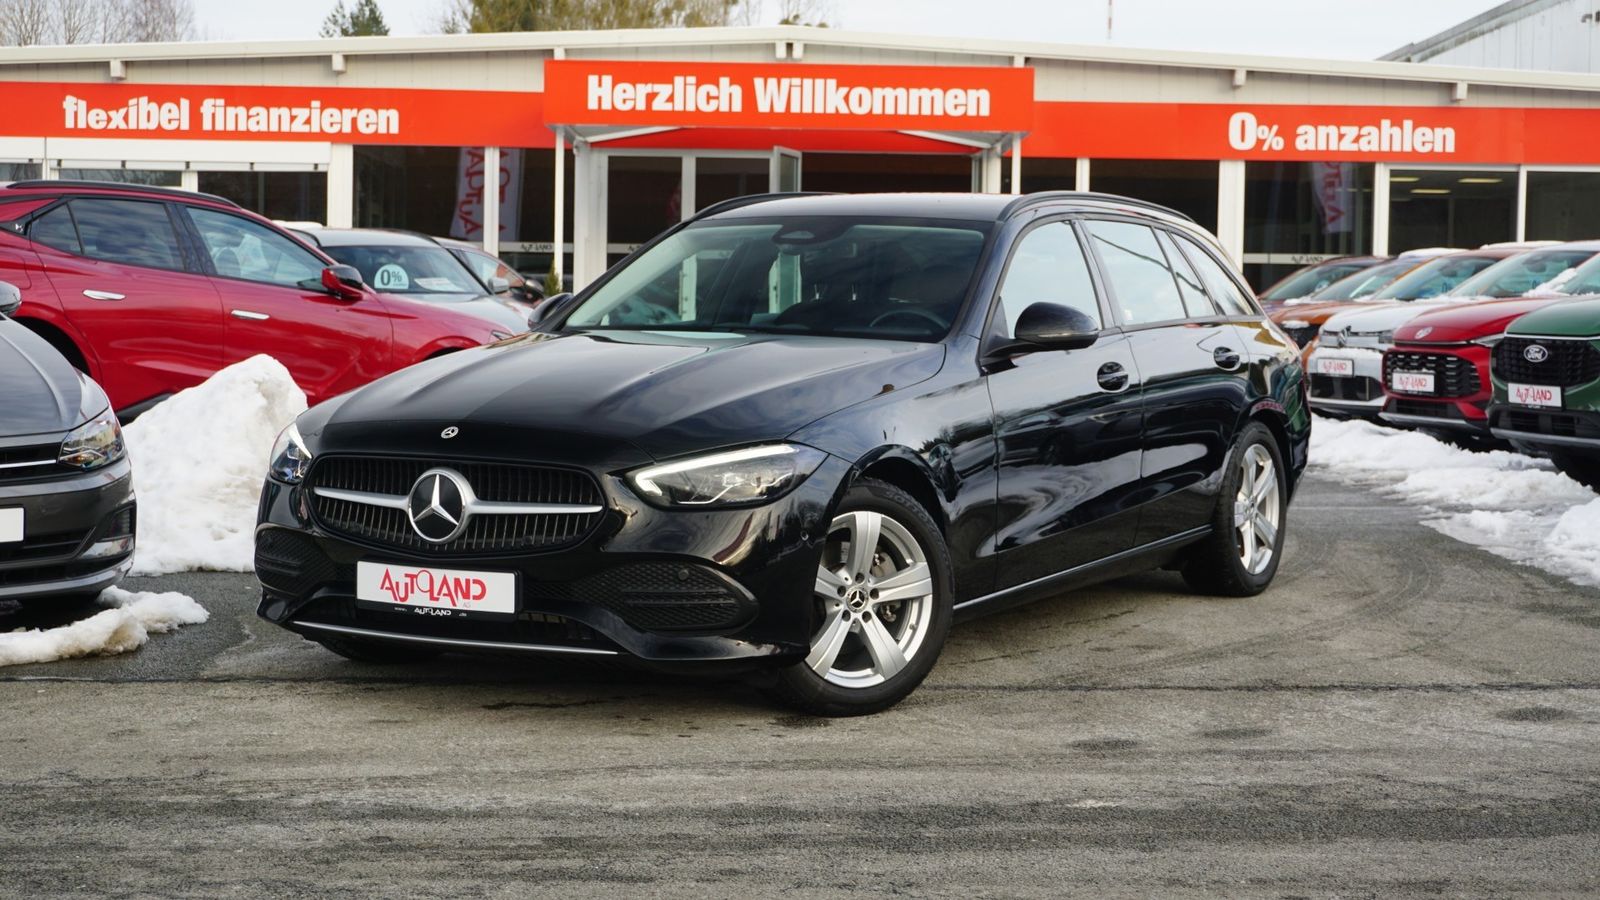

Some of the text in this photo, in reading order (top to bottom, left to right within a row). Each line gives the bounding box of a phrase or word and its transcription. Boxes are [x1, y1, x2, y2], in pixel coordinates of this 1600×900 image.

[63, 95, 399, 134] flexibel finanzieren
[588, 75, 990, 117] Herzlich Willkommen
[1228, 112, 1456, 153] 0% anzahlen
[380, 269, 403, 286] 0%
[380, 568, 487, 607] AUTOLAND
[414, 607, 451, 616] AUTOLAND
